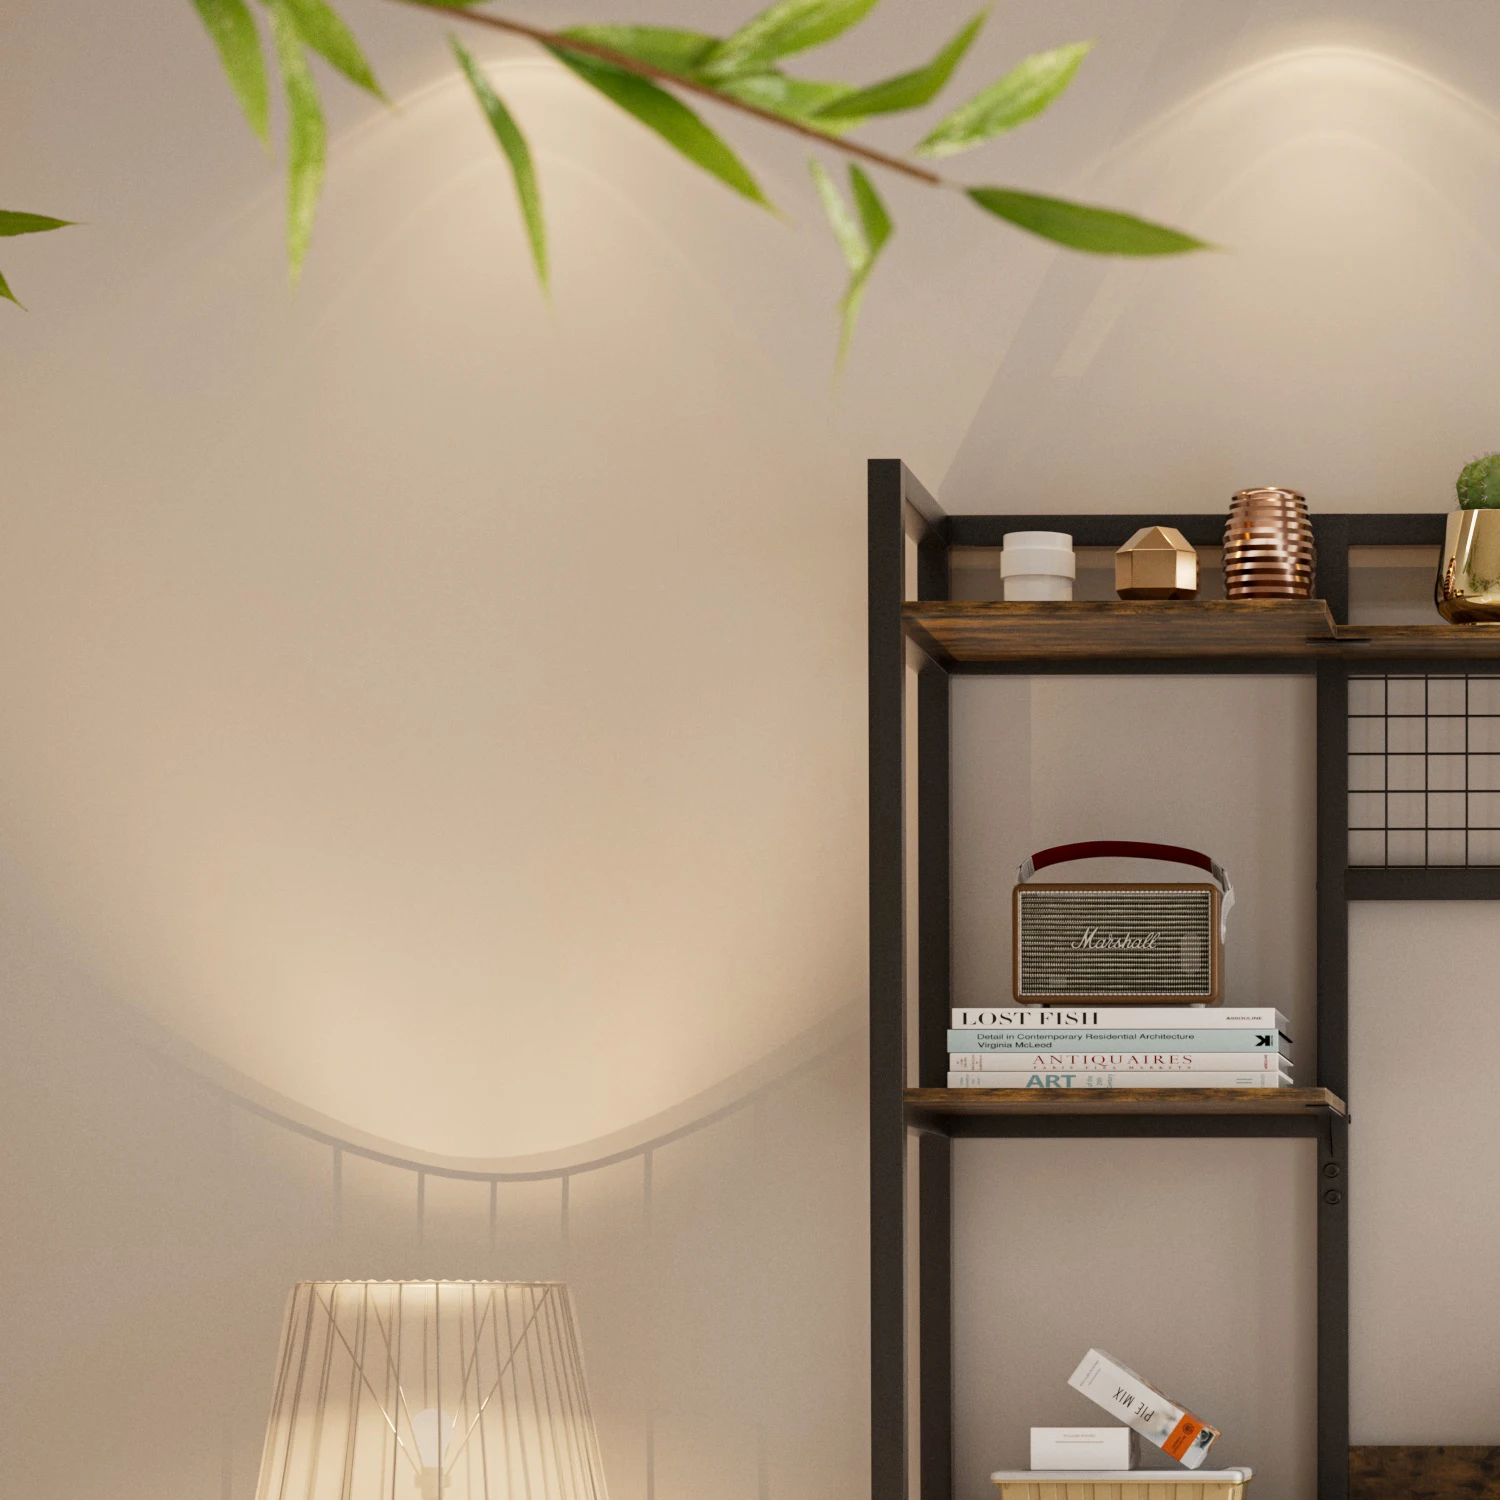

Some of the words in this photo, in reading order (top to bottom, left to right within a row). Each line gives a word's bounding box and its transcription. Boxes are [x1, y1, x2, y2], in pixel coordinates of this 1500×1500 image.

[1071, 926, 1160, 950] Marshall
[962, 1012, 1031, 1025] LOST
[1040, 1012, 1098, 1025] FISH
[1021, 1033, 1083, 1042] Contemporary
[1033, 1055, 1193, 1066] ANTIQUAIRES
[1025, 1074, 1077, 1088] ART
[1112, 1387, 1136, 1408] MIX
[1134, 1401, 1155, 1422] PIE
